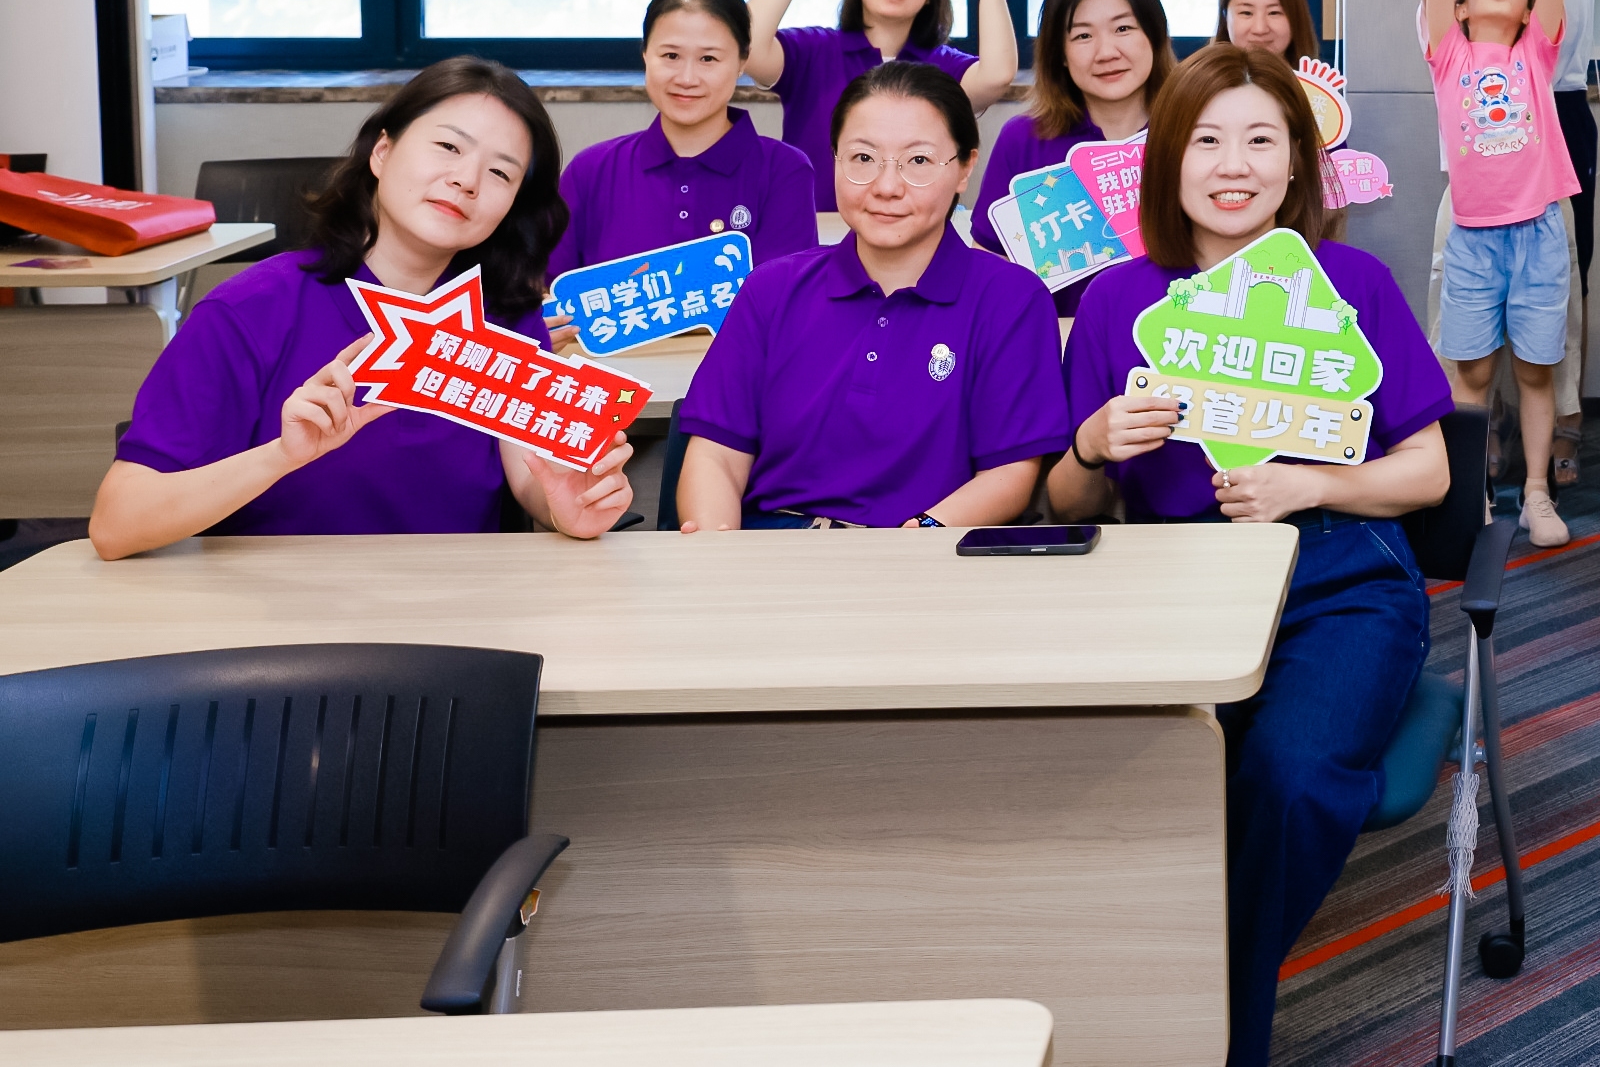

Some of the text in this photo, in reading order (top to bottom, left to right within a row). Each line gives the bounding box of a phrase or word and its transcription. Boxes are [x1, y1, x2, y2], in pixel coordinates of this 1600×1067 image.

[1090, 145, 1142, 172] SEM
[1096, 165, 1142, 194] 我的
[1029, 199, 1094, 249] 打卡
[424, 328, 612, 417] 预测不了未来
[1158, 326, 1357, 394] 欢迎回家
[411, 365, 598, 453] 但能创造未来
[1151, 382, 1344, 450] 经管少年
